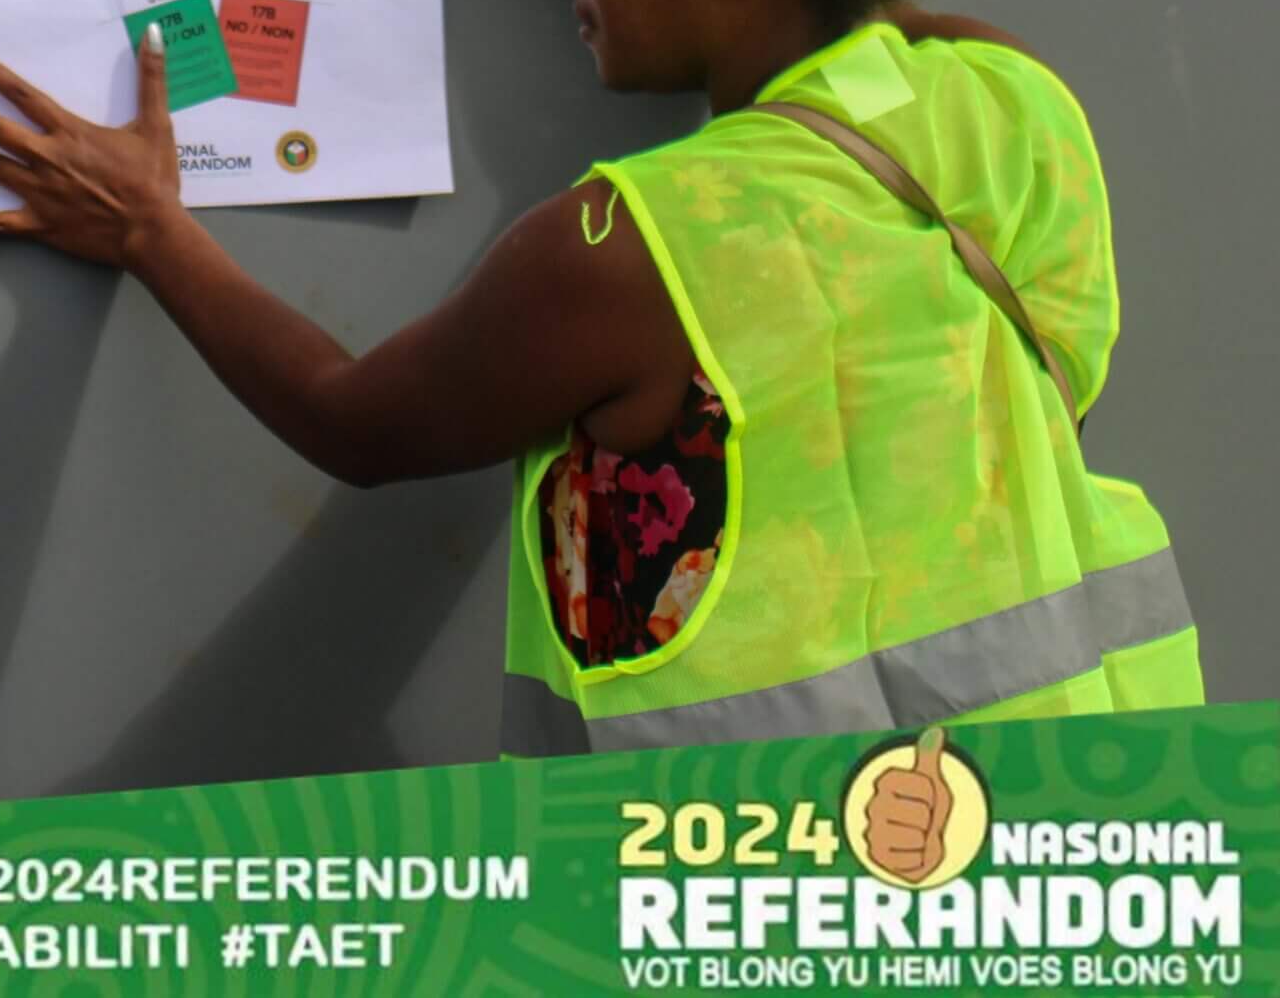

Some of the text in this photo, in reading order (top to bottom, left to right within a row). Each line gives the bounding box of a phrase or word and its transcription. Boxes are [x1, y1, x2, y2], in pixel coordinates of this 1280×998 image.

[251, 5, 276, 20] 17B
[159, 12, 184, 29] 17B
[181, 24, 206, 39] OUI
[226, 20, 248, 33] NO
[262, 26, 294, 40] NON
[176, 144, 218, 158] ONAL
[180, 156, 252, 172] RANDOM
